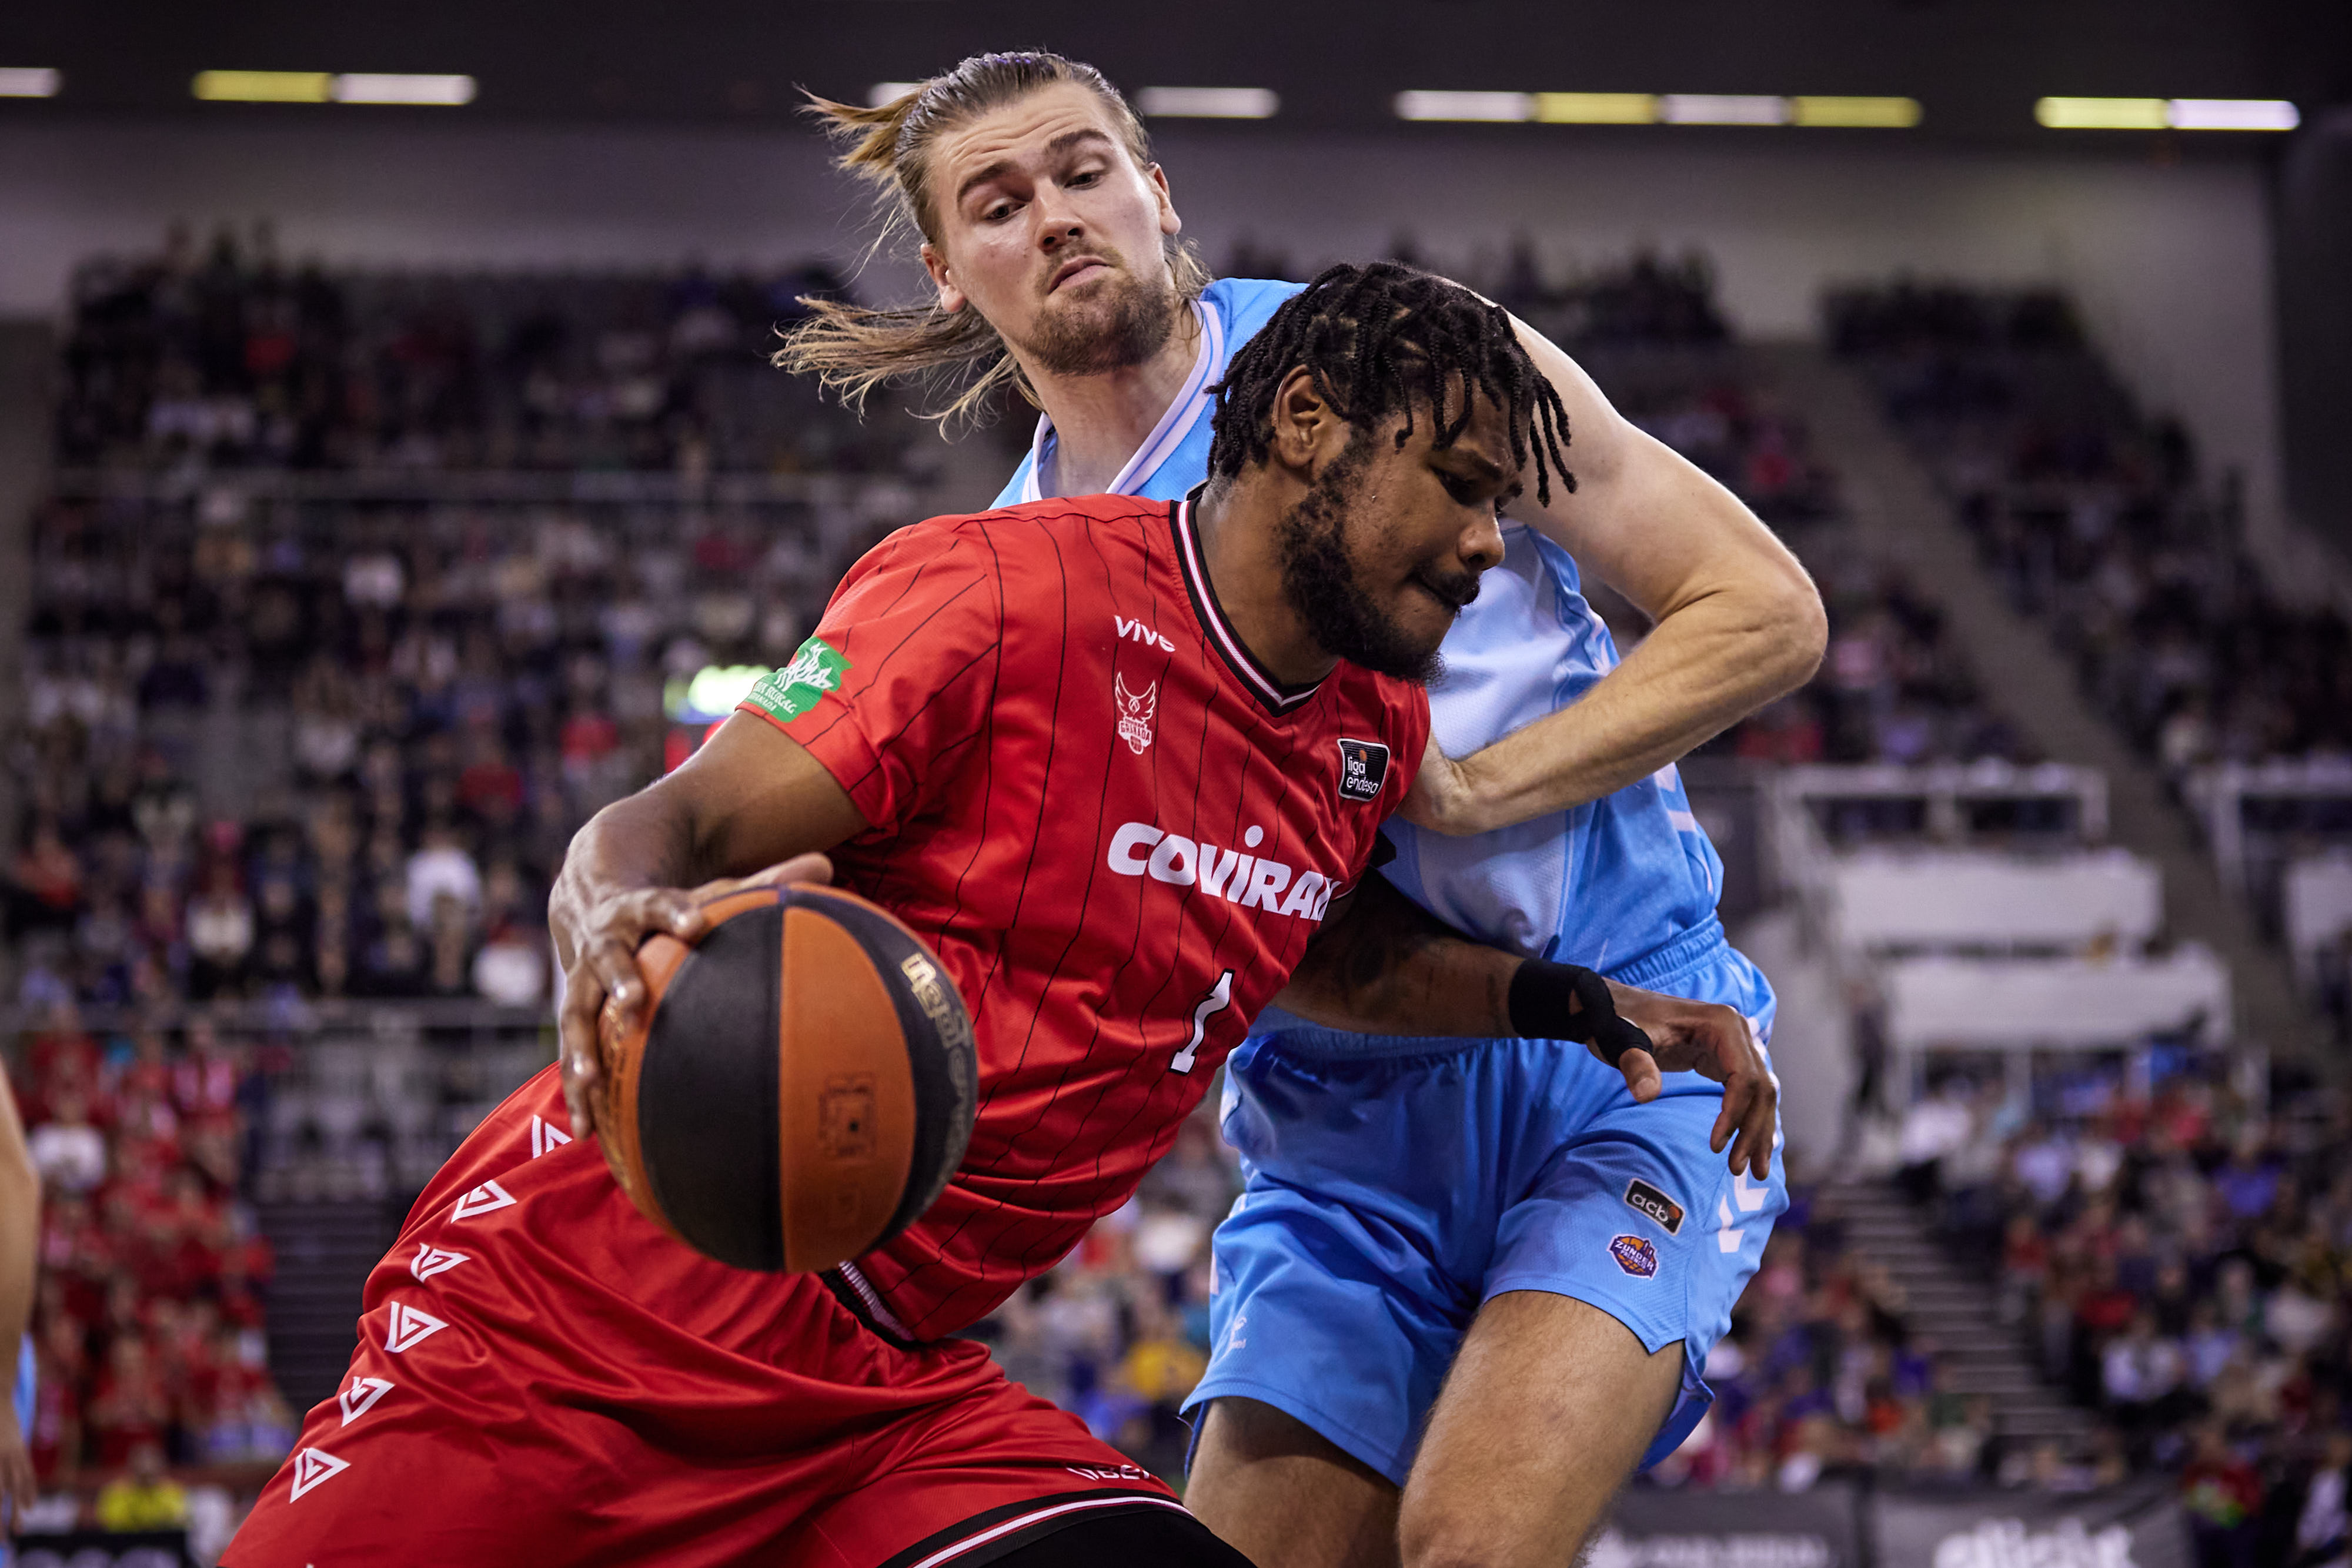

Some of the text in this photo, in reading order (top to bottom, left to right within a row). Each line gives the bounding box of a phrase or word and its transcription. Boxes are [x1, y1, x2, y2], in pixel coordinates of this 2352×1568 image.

[1347, 756, 1365, 775] liga
[1347, 776, 1379, 794] endesa
[1168, 969, 1235, 1076] 1
[1632, 1193, 1669, 1223] acb
[1615, 1241, 1654, 1271] ZUNDER
